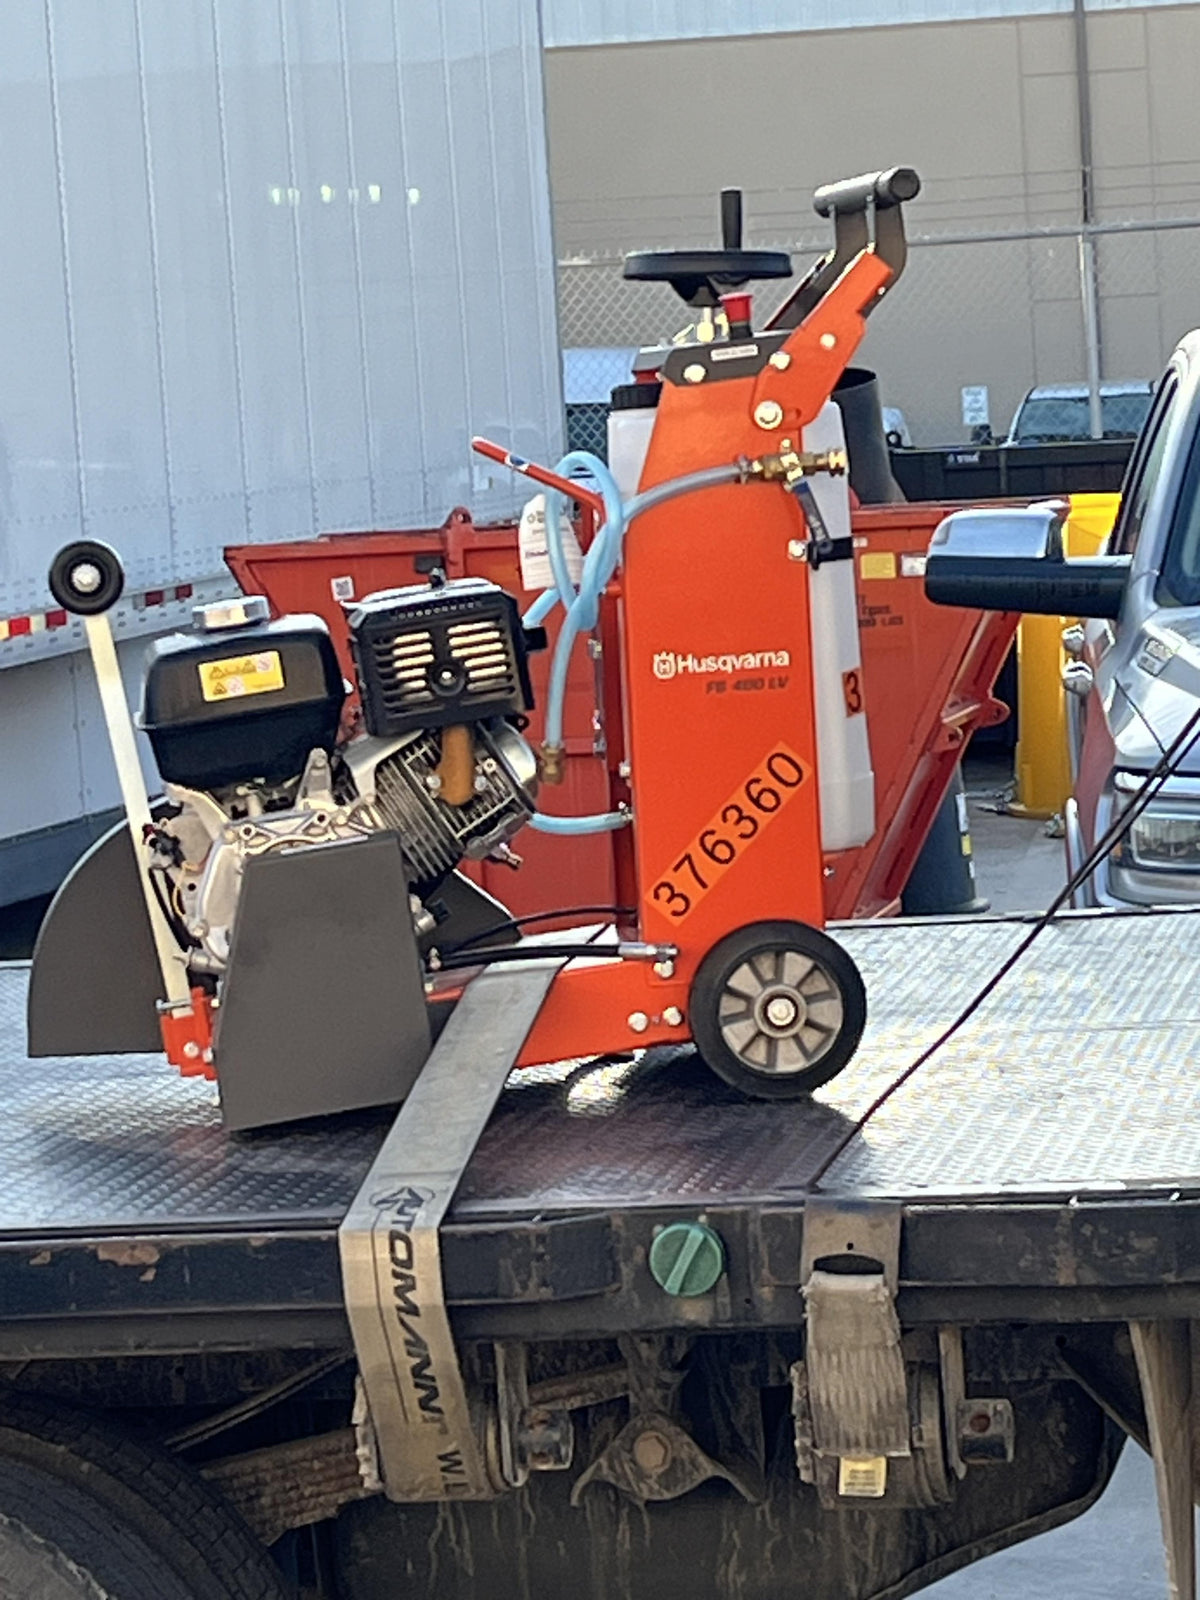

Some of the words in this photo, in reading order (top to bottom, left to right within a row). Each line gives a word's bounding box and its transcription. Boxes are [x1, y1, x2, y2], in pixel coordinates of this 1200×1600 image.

[676, 651, 789, 674] Husqvarna
[845, 671, 861, 712] 3
[653, 752, 804, 917] 376360
